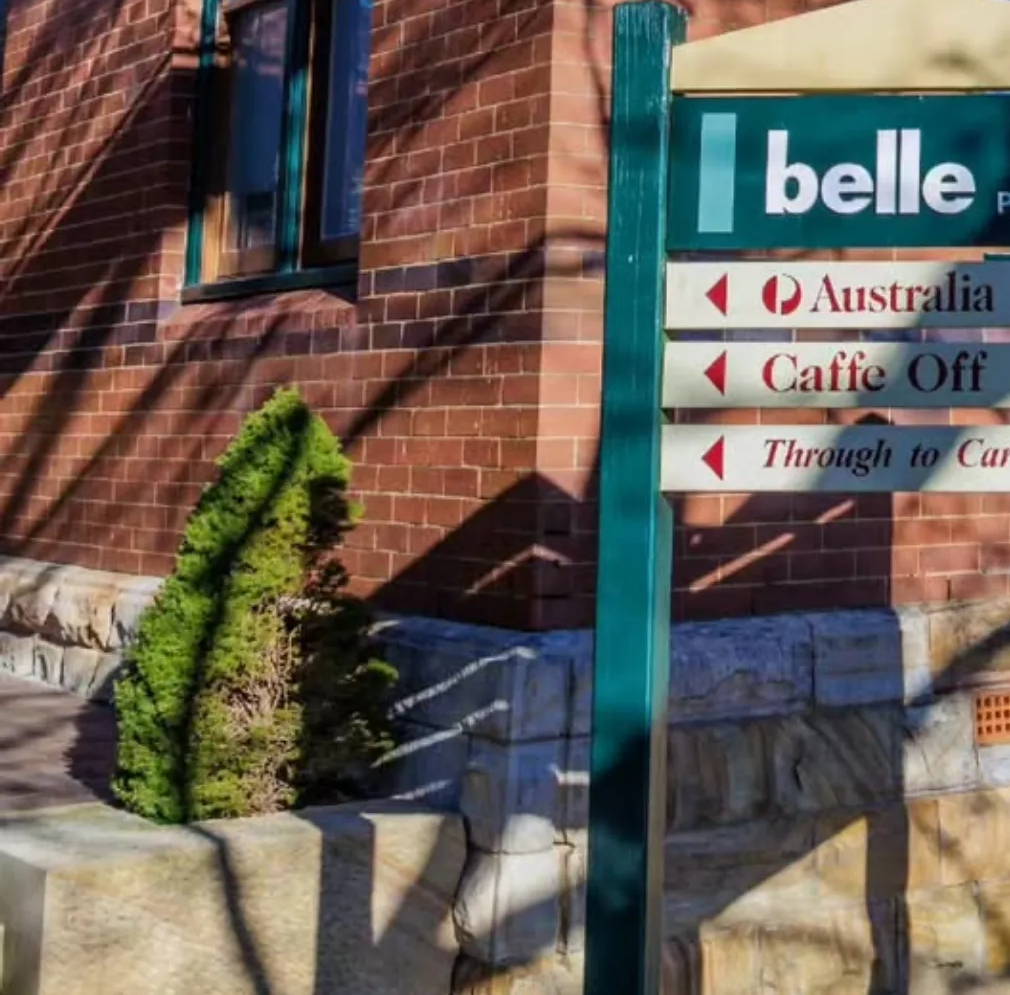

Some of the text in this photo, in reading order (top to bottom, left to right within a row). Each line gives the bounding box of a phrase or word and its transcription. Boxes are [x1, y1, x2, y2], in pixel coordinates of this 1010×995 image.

[765, 129, 976, 214] belle
[809, 272, 994, 313] Australia
[762, 352, 886, 392] Caffe
[907, 351, 987, 392] Off
[762, 438, 892, 477] Through
[910, 441, 939, 468] to
